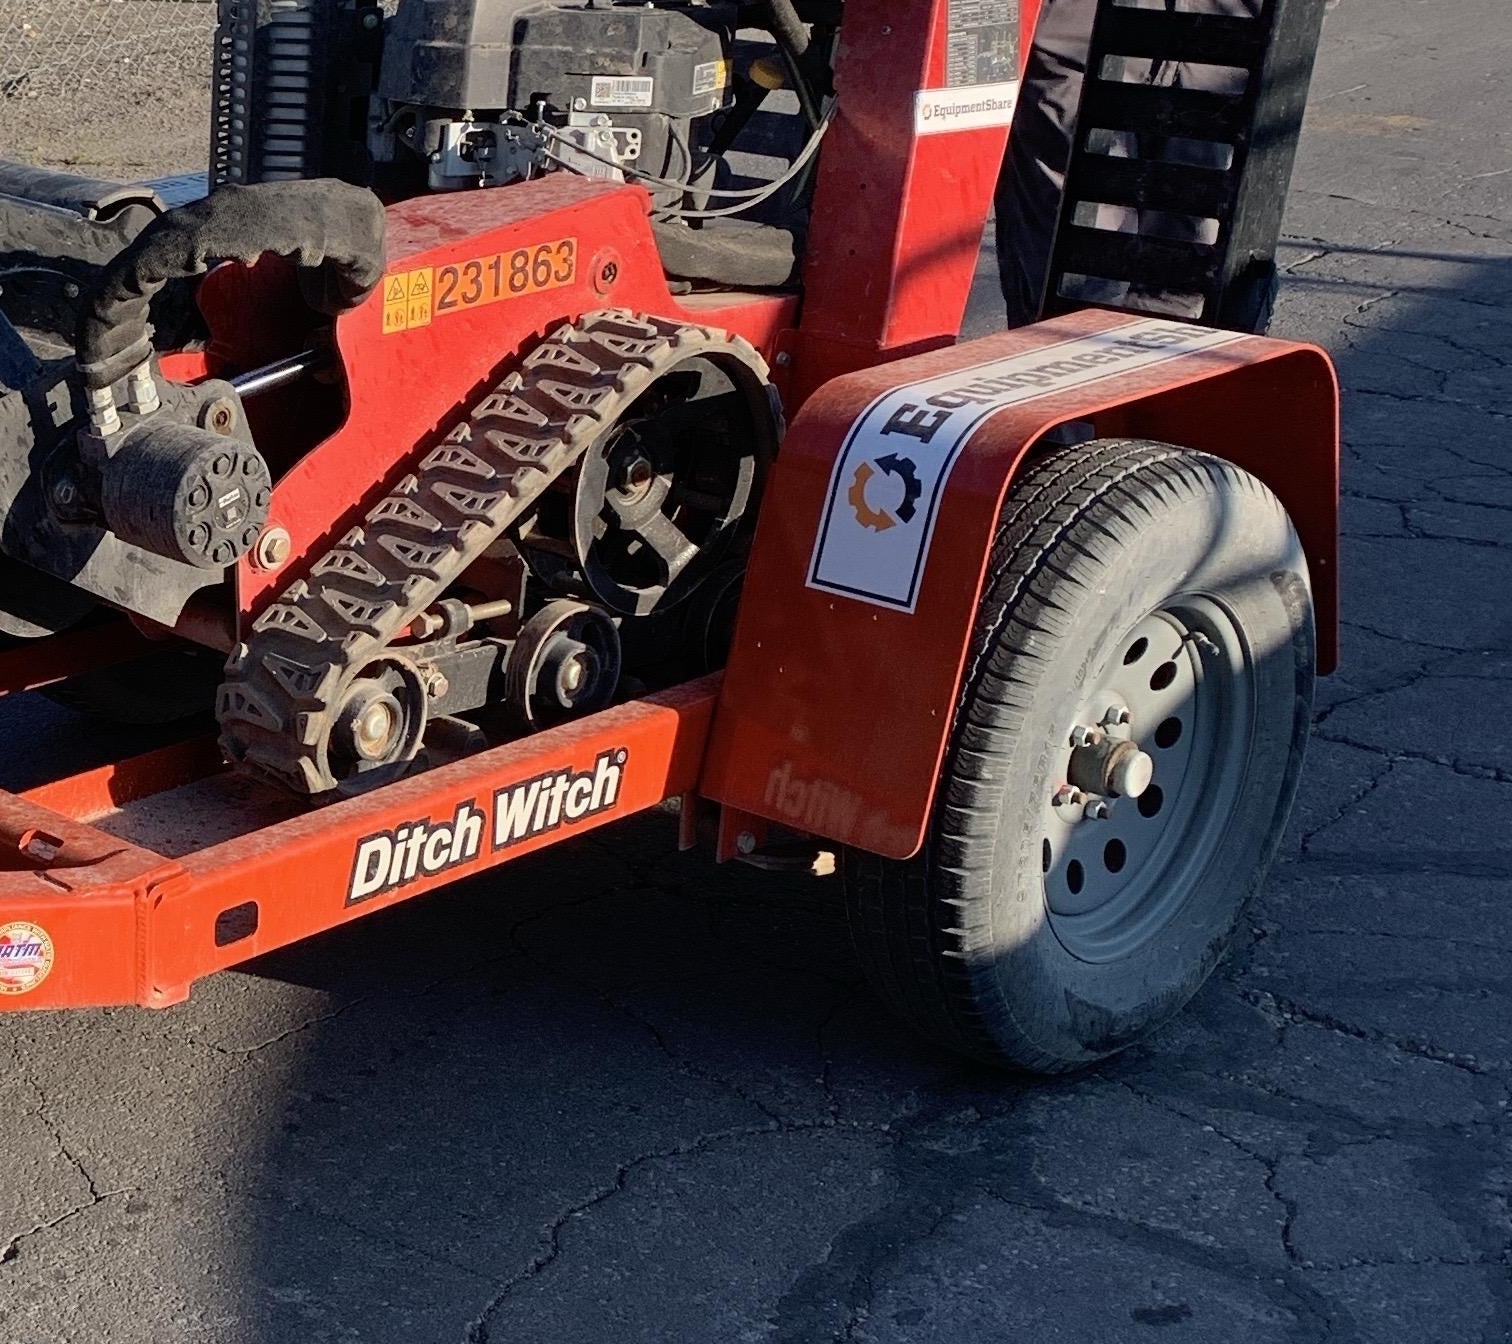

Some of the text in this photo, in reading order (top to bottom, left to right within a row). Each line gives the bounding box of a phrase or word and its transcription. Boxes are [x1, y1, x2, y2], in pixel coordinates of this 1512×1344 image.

[933, 98, 1013, 121] EquipmentShare
[437, 239, 575, 311] 231863
[879, 326, 1218, 444] EquipmentSh
[348, 754, 621, 902] Ditch Witch
